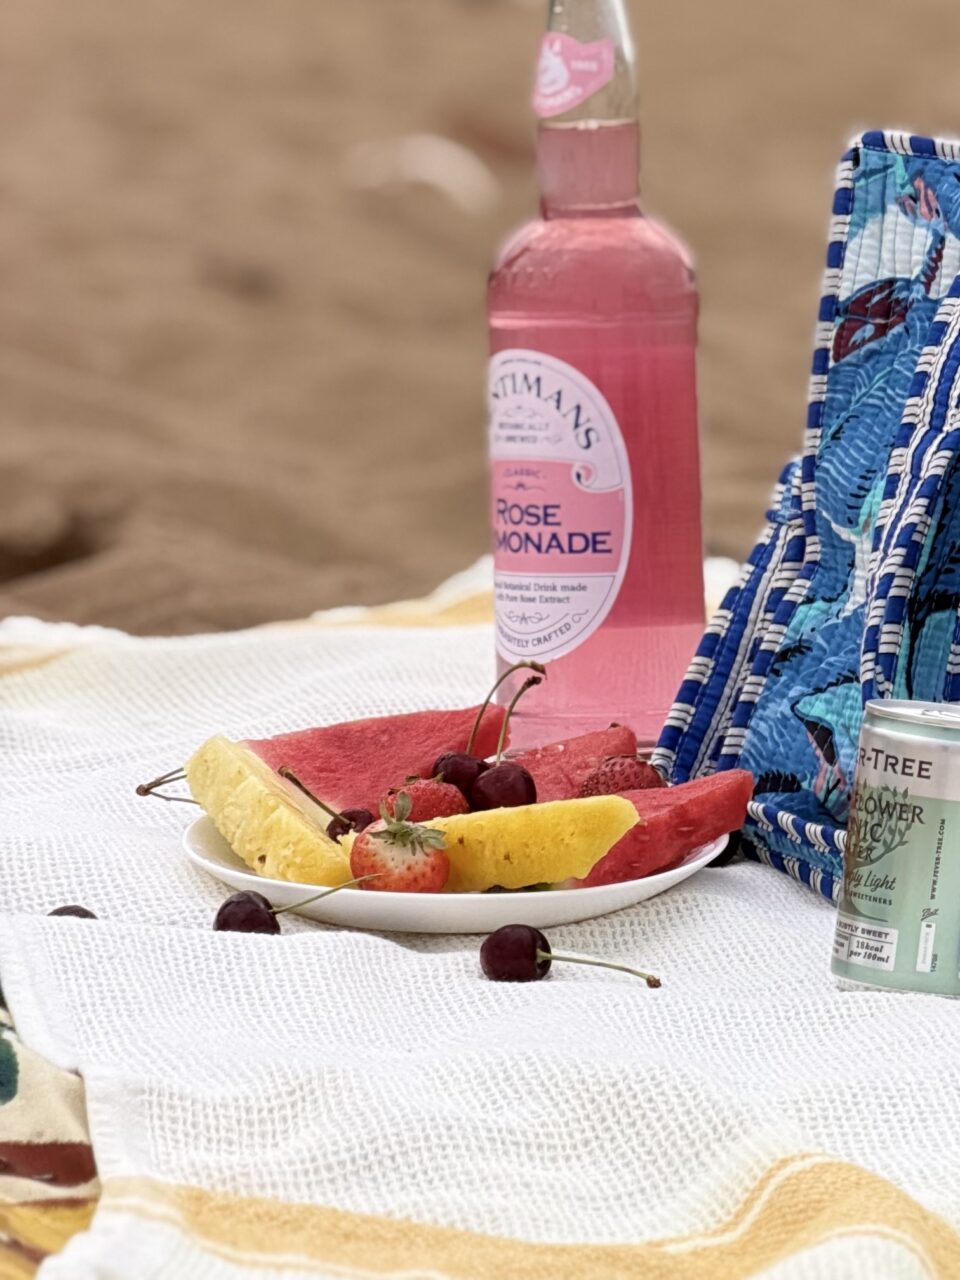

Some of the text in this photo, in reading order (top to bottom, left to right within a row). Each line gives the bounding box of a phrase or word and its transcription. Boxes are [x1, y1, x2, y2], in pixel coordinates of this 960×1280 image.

[497, 498, 562, 526] ROSE
[533, 582, 558, 592] Drink
[560, 583, 588, 592] made
[539, 595, 571, 605] Extract
[531, 622, 572, 647] CRAFTED
[930, 818, 946, 900] WWW.FEVER-TREE.COM
[863, 870, 897, 892] Light
[861, 927, 890, 940] SWEET
